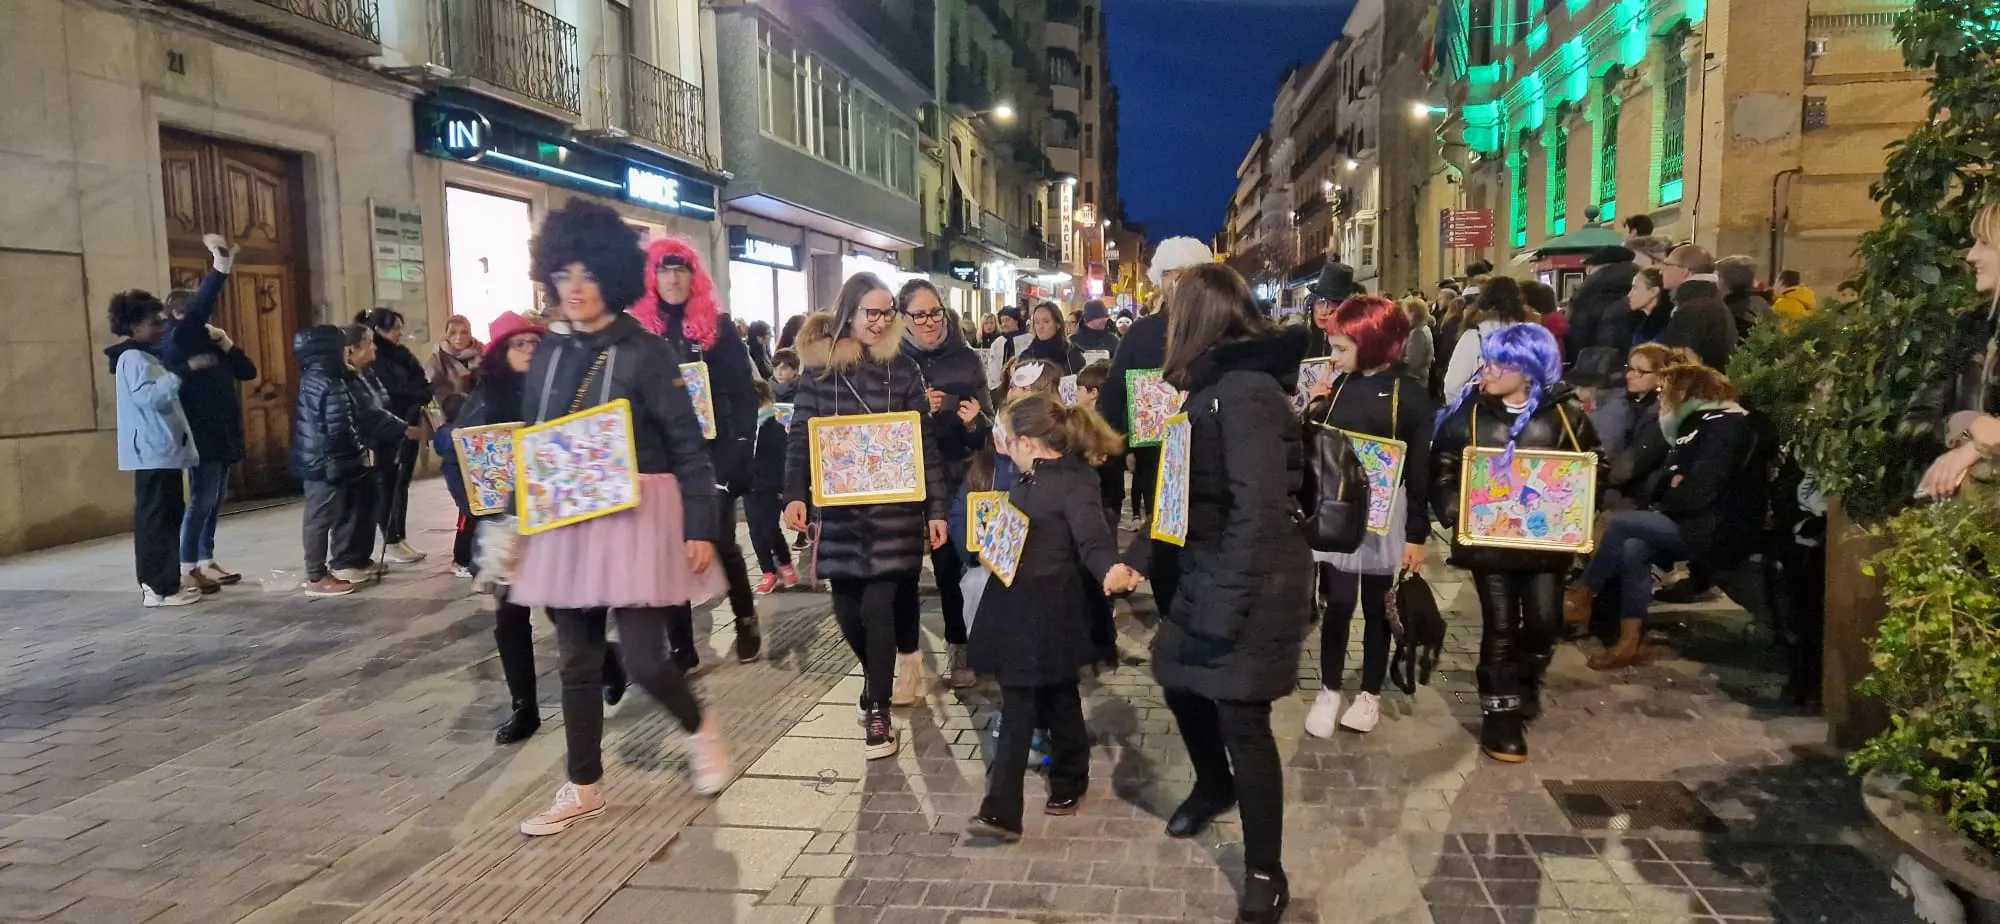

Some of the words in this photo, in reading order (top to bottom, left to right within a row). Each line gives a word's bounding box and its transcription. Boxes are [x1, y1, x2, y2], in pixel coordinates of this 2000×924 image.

[166, 49, 185, 76] 21
[449, 120, 479, 148] IN
[1062, 184, 1071, 262] FARMACIA
